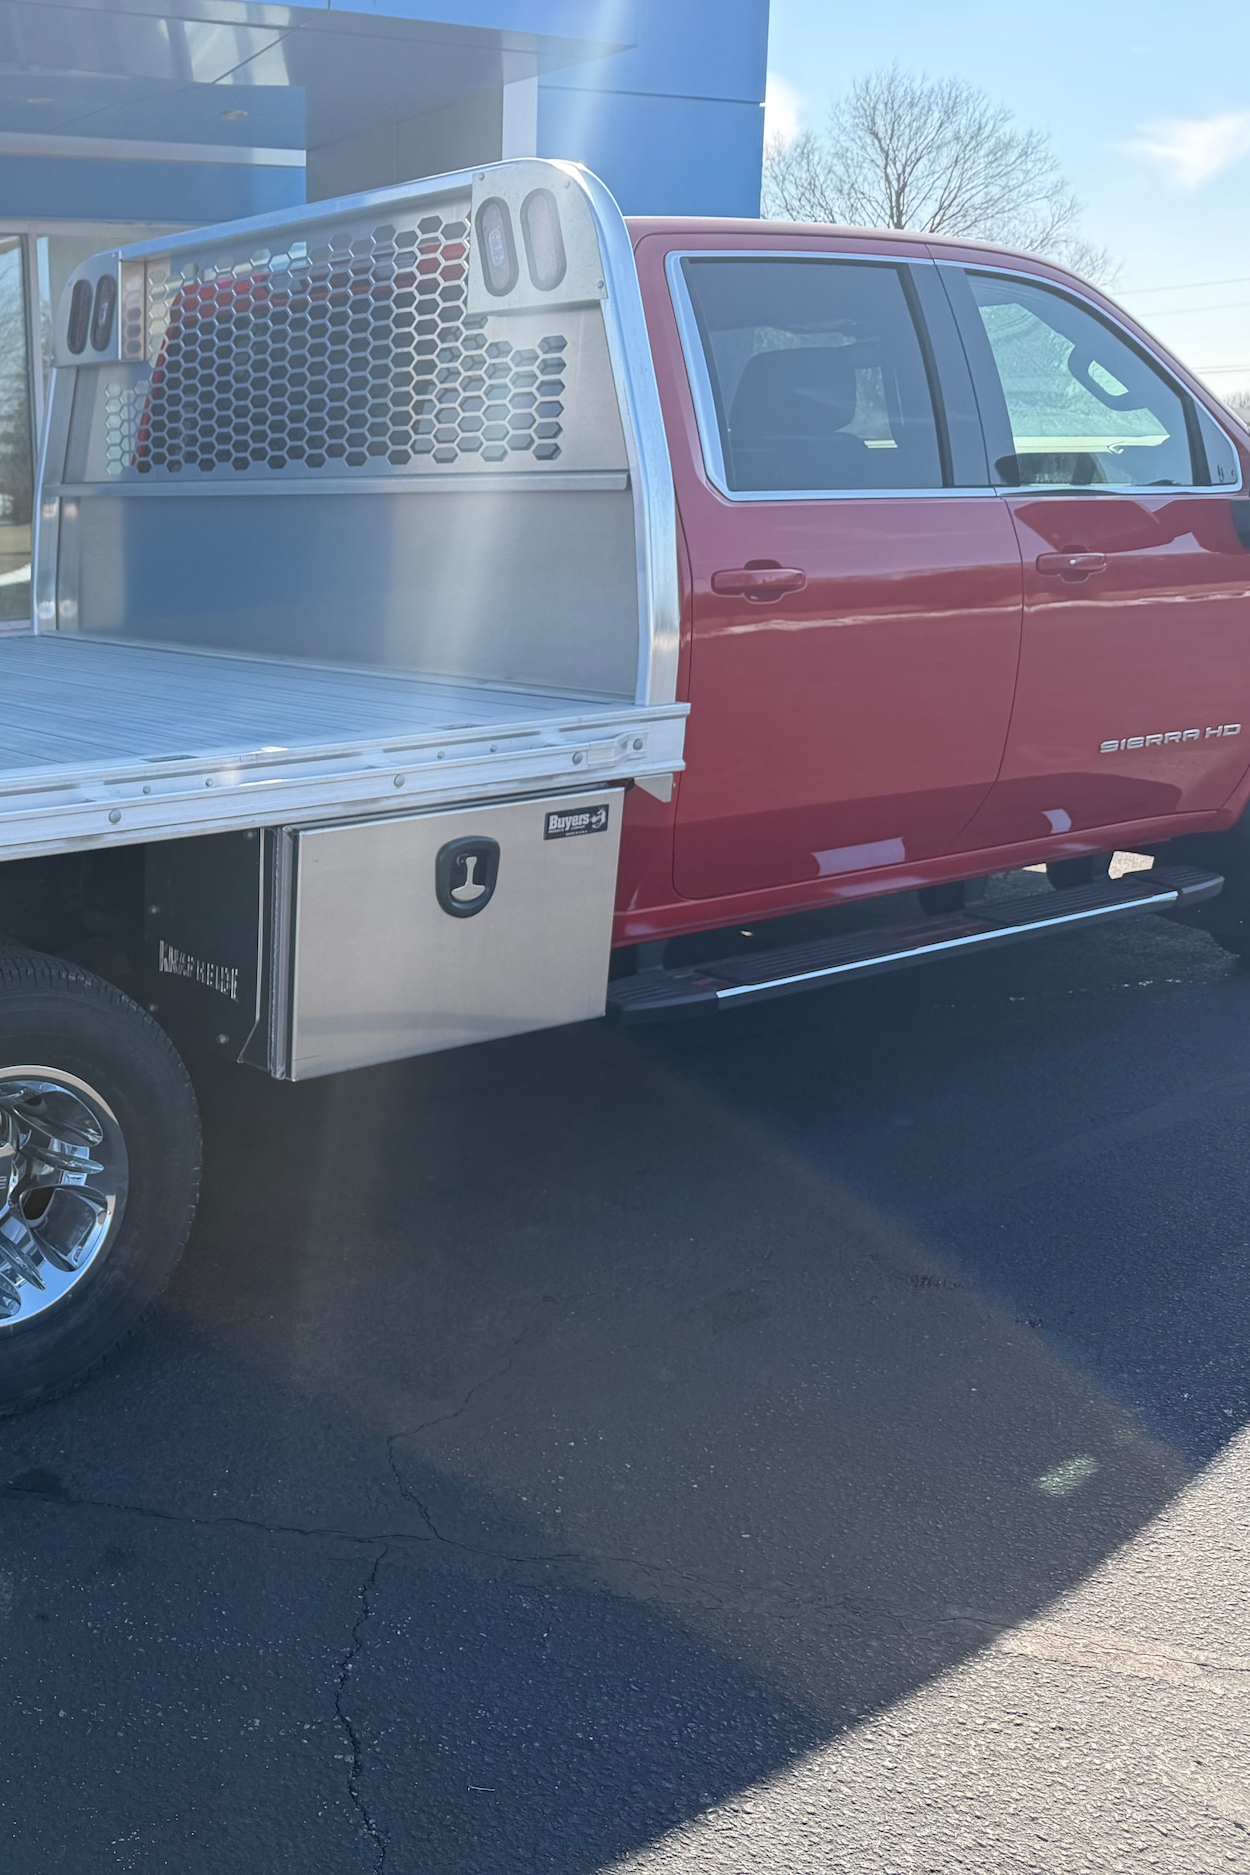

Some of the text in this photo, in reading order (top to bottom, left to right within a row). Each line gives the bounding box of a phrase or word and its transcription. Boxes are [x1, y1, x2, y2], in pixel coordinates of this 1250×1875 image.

[1099, 723, 1242, 753] SIERRA HD
[549, 813, 591, 831] Buyers
